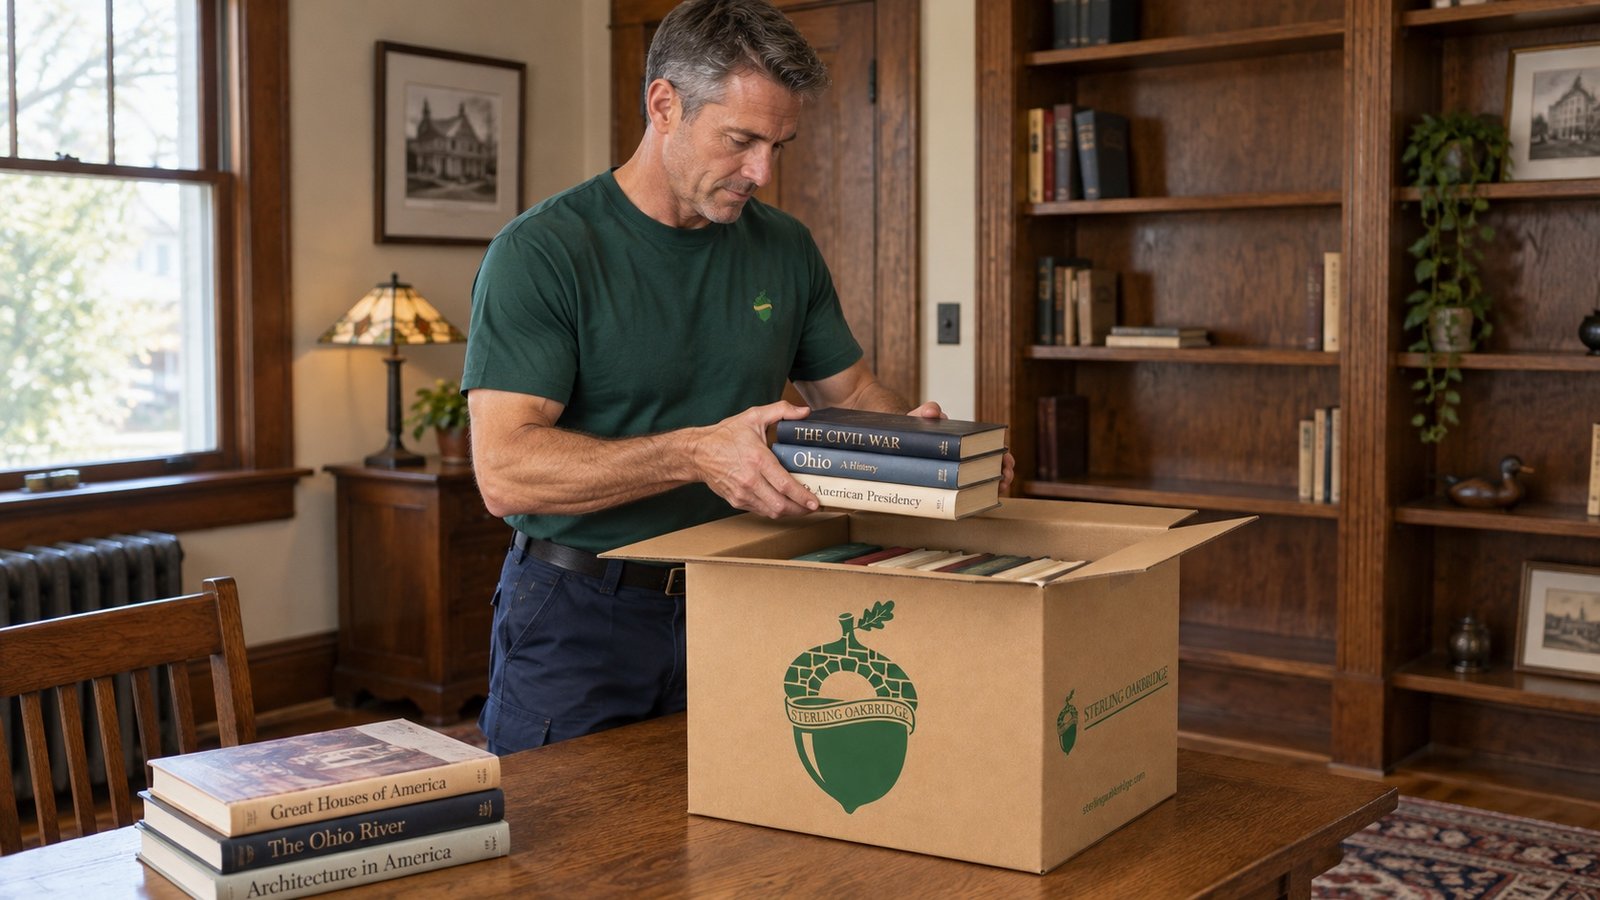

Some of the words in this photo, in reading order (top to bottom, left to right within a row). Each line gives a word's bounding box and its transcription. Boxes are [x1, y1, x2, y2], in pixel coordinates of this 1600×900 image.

[794, 427, 823, 441] THE
[826, 430, 865, 446] CIVIL
[869, 434, 900, 449] WAR
[793, 451, 832, 469] Ohio
[867, 490, 922, 508] Presidency
[791, 709, 842, 723] STERLING
[844, 703, 909, 720] OAKBRIDGE
[1084, 688, 1124, 723] STERLING
[270, 802, 313, 820] Great
[317, 790, 369, 812] Houses
[372, 784, 388, 802] of
[390, 778, 447, 799] America
[268, 837, 304, 859] The
[309, 829, 355, 850] Ohio
[359, 819, 406, 842] River
[246, 866, 357, 899] Architecture
[362, 852, 378, 875] in
[383, 846, 452, 871] America
